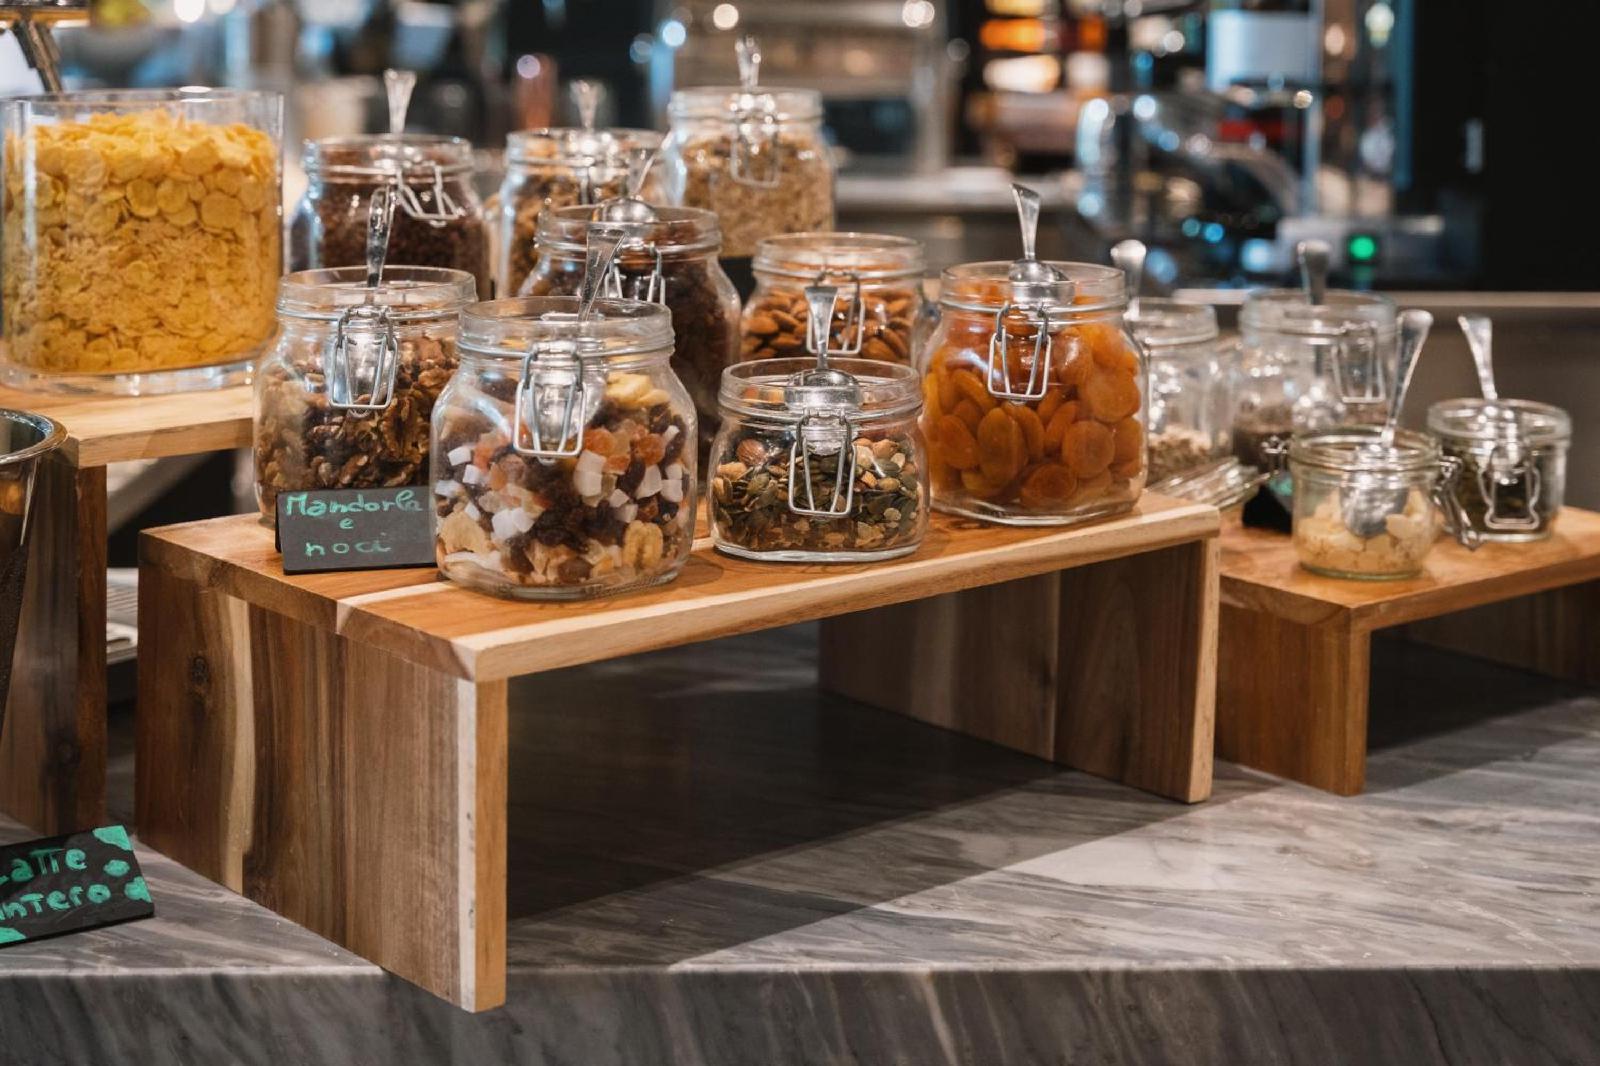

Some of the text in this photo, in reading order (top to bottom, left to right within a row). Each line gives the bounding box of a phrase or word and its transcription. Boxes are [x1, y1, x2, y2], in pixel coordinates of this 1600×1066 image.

[286, 489, 422, 516] Mandorla
[339, 518, 354, 529] e
[305, 532, 391, 557] noci
